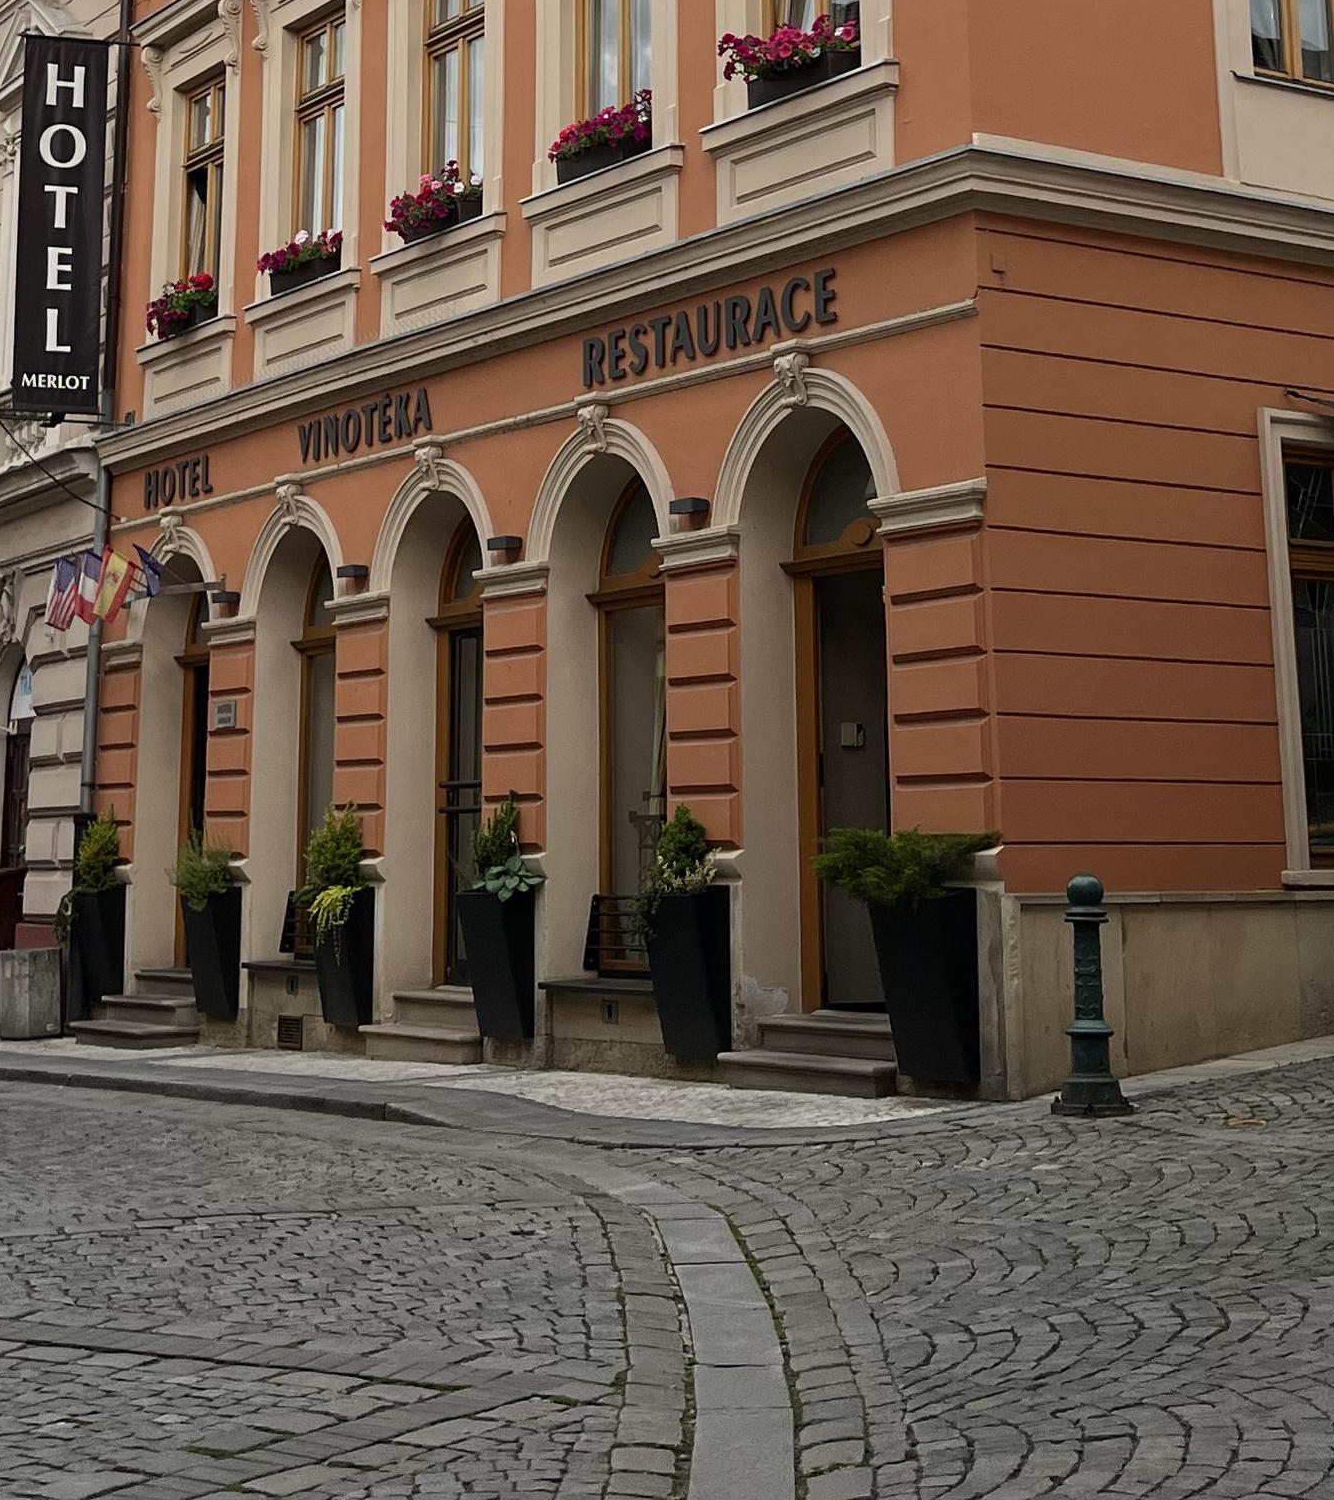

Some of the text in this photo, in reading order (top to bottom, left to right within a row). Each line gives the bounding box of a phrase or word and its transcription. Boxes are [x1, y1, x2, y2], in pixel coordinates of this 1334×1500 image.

[39, 62, 87, 353] HOTEL
[582, 267, 839, 389] RESTAURACE
[21, 372, 90, 391] MERLOT
[297, 387, 433, 464] VINOTÉKA
[143, 454, 214, 510] HOTEL
